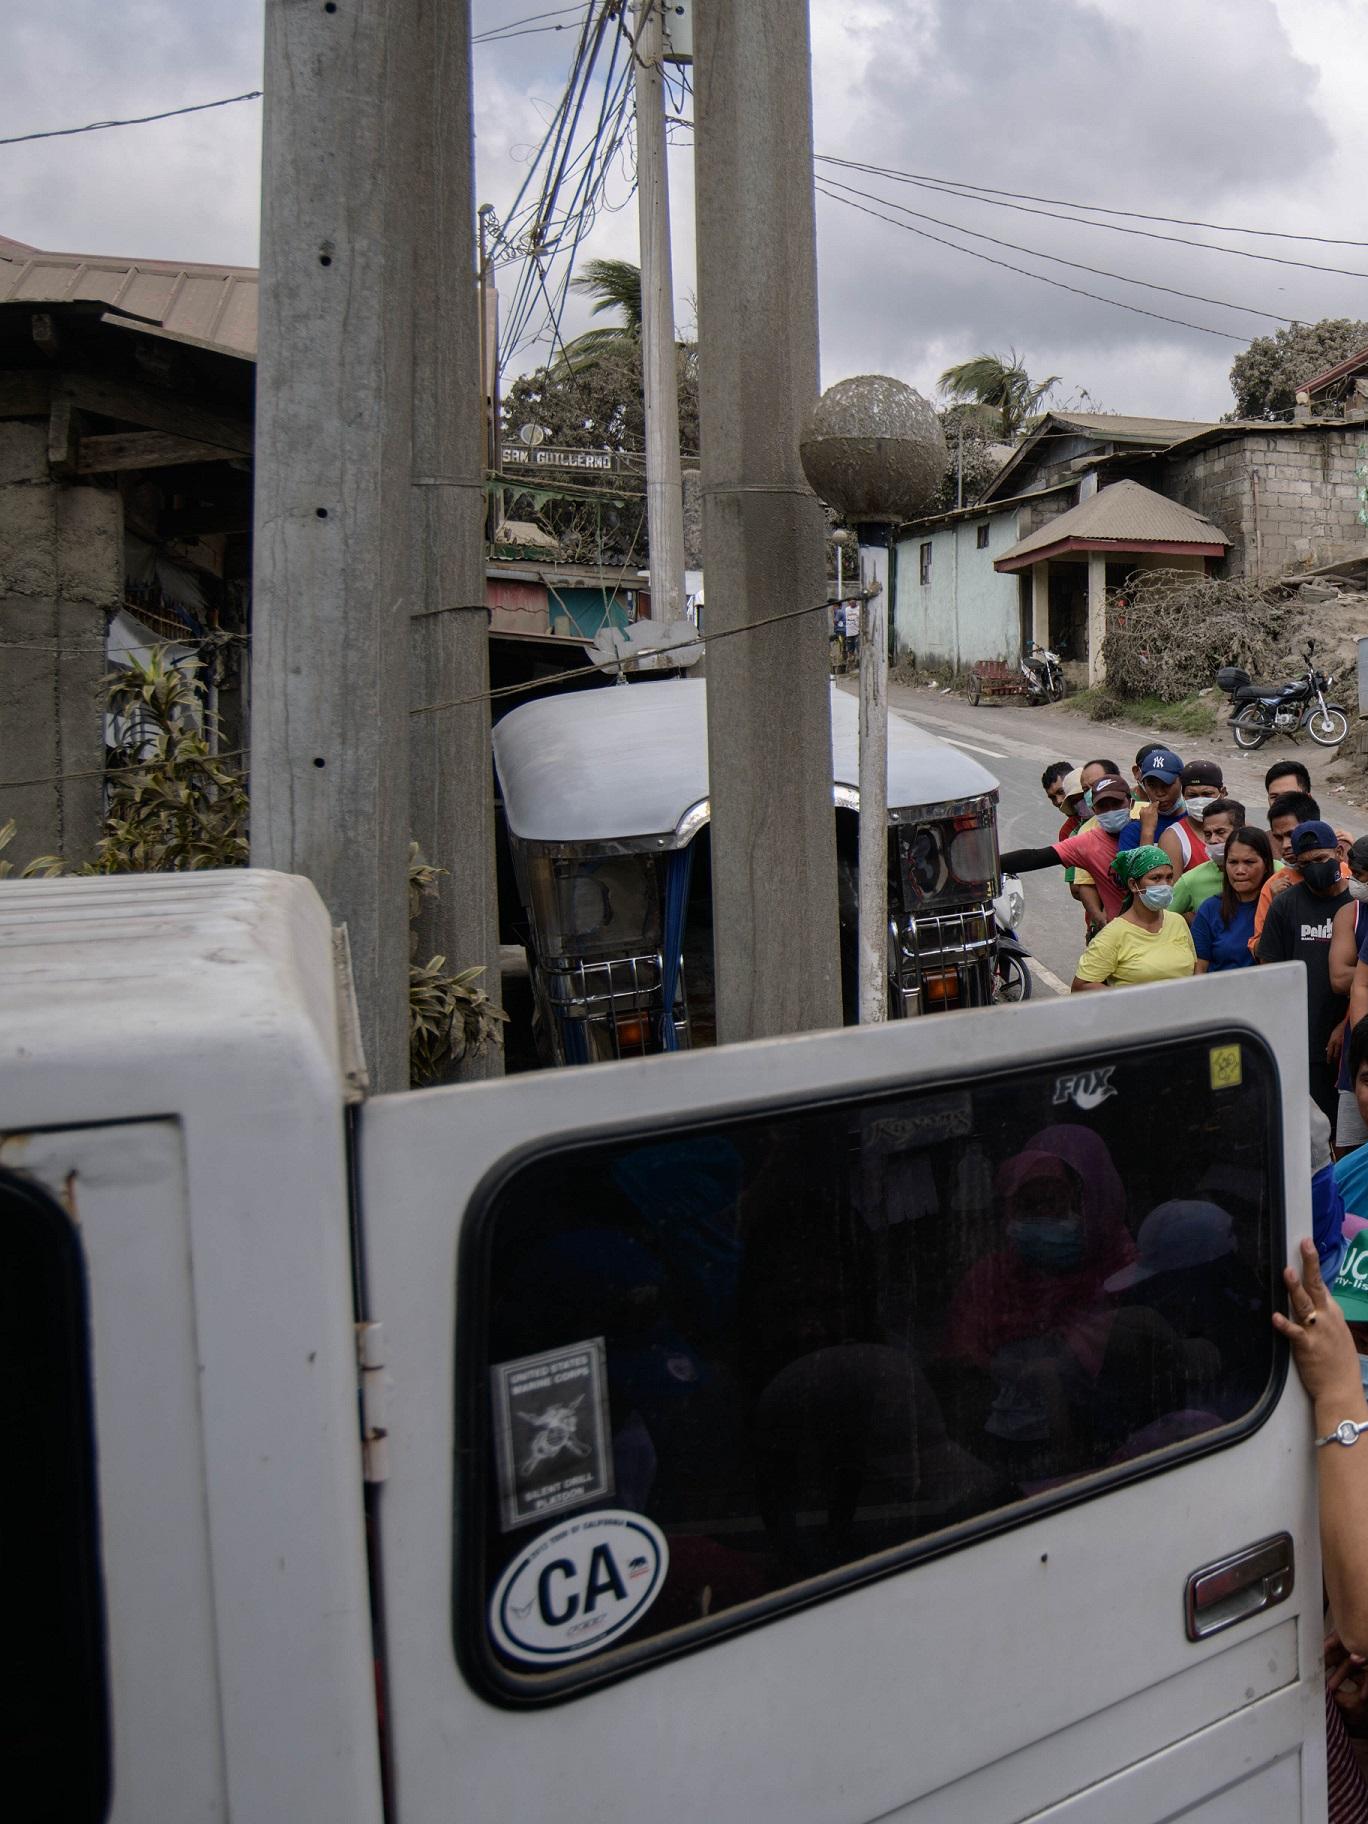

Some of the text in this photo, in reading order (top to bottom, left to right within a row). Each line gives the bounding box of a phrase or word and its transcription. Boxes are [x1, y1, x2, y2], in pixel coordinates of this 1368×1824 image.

[502, 449, 611, 468] SAN GUILLERMO
[1052, 1064, 1118, 1110] FOX
[550, 1355, 588, 1374] STATES
[513, 1366, 589, 1396] MARINE CORPS
[538, 1542, 628, 1627] CA
